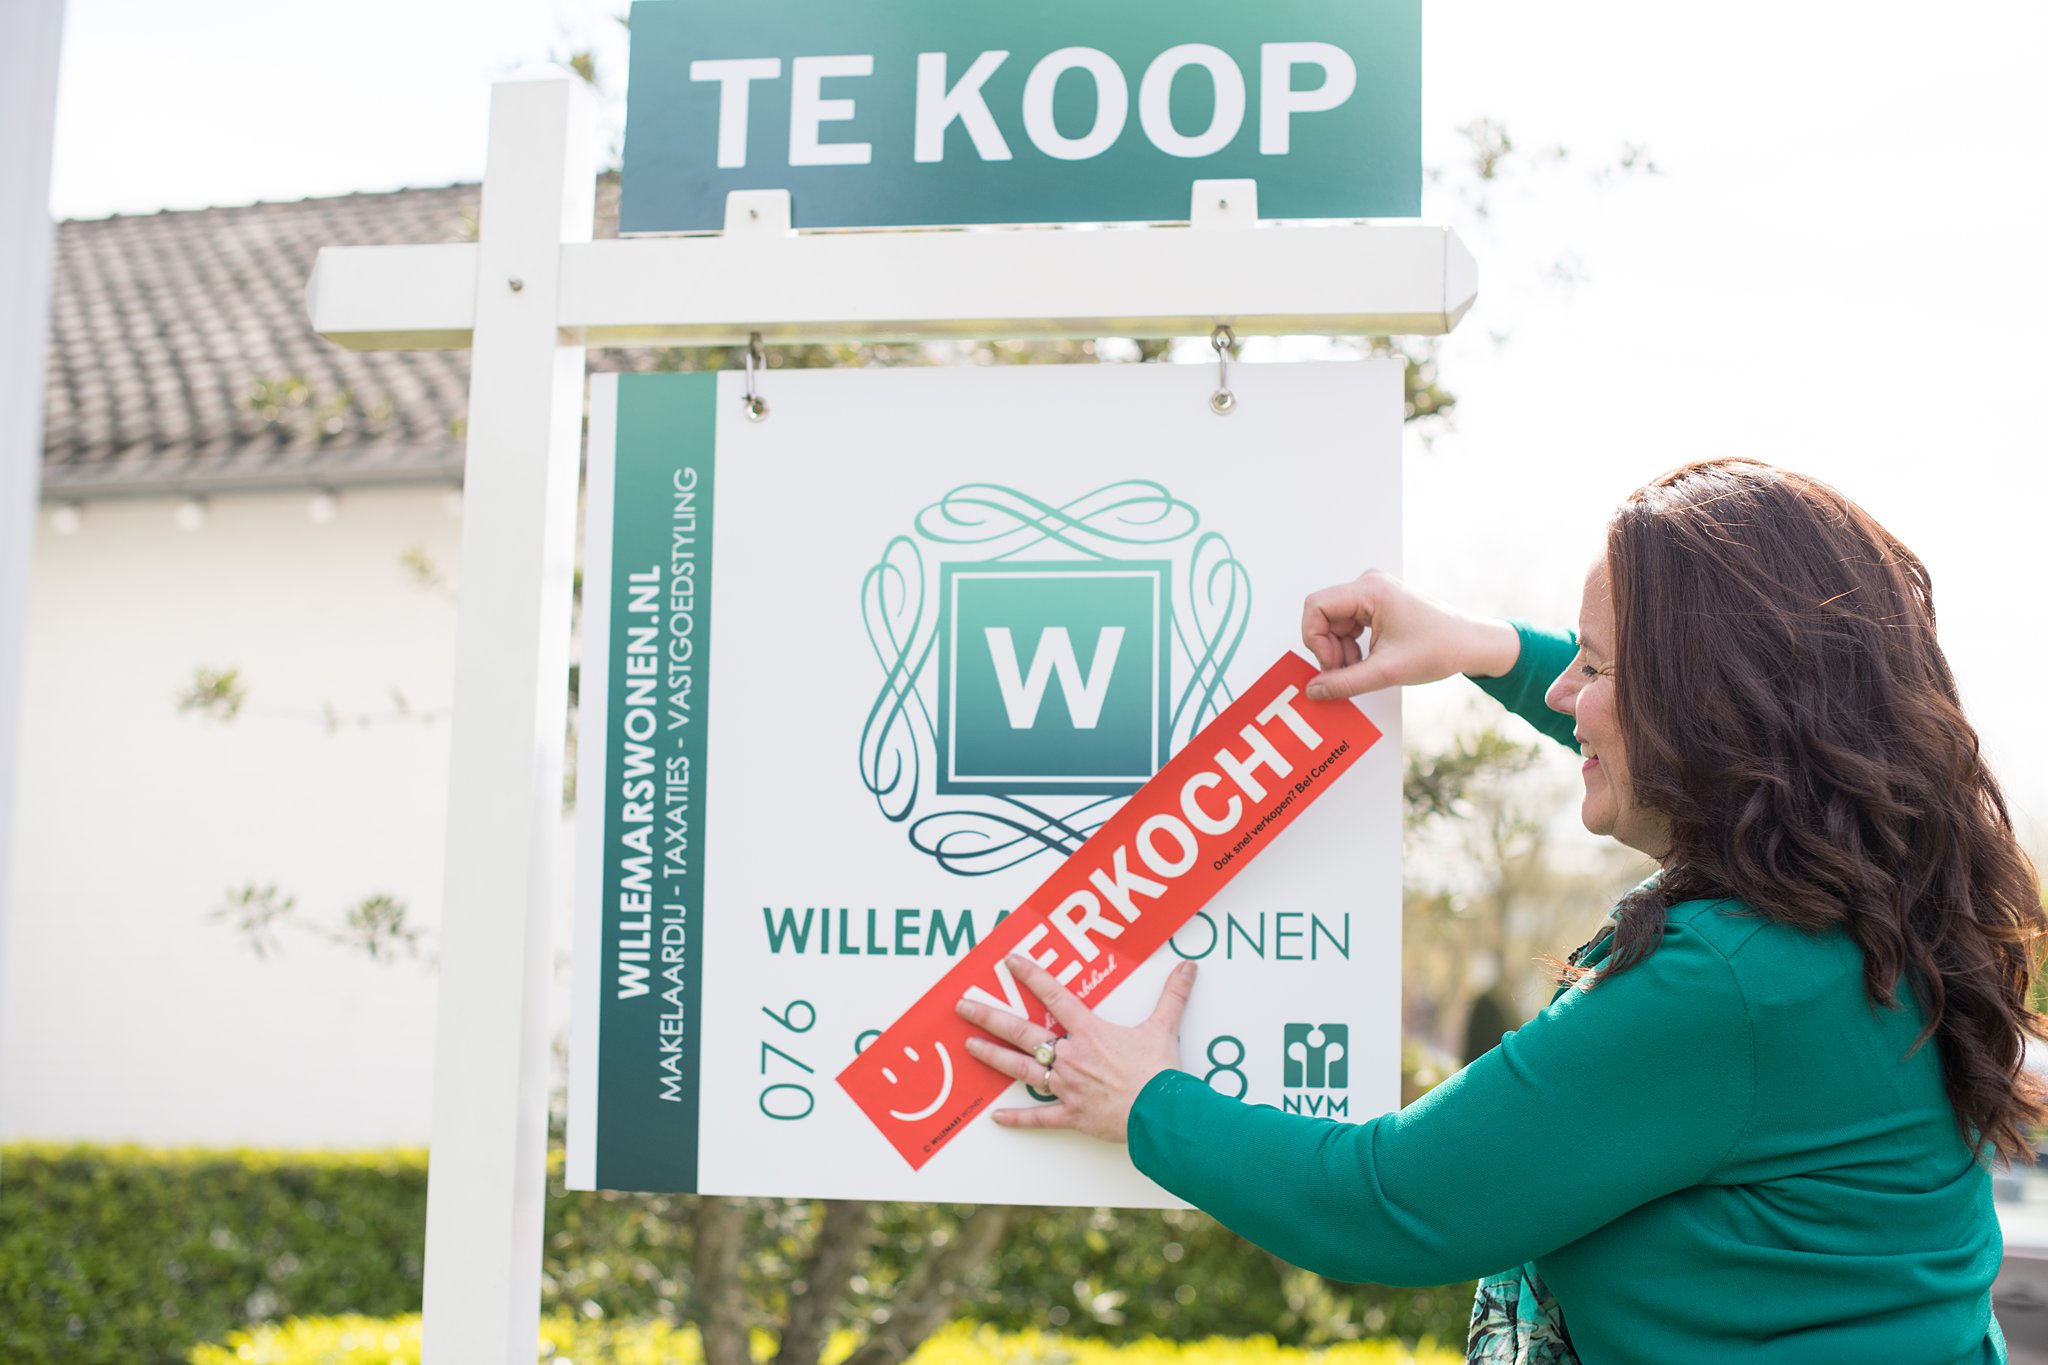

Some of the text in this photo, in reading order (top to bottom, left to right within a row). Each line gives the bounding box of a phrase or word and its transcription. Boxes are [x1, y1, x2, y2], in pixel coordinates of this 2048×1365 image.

[690, 42, 1357, 168] TE KOOP
[667, 467, 698, 730] VASTGOEDSTYLING
[984, 626, 1126, 729] W
[617, 565, 660, 1000] WILLEMARSWONEN.NL
[663, 756, 690, 877] TAXATIES
[1213, 740, 1350, 871] Ook snel verkopen? Bel Corette!
[963, 684, 1324, 1021] VERKOCHT
[762, 907, 1349, 960] WILLEM ONEN
[659, 903, 687, 1102] MAKELAARDIJ
[1283, 1094, 1348, 1117] NVM
